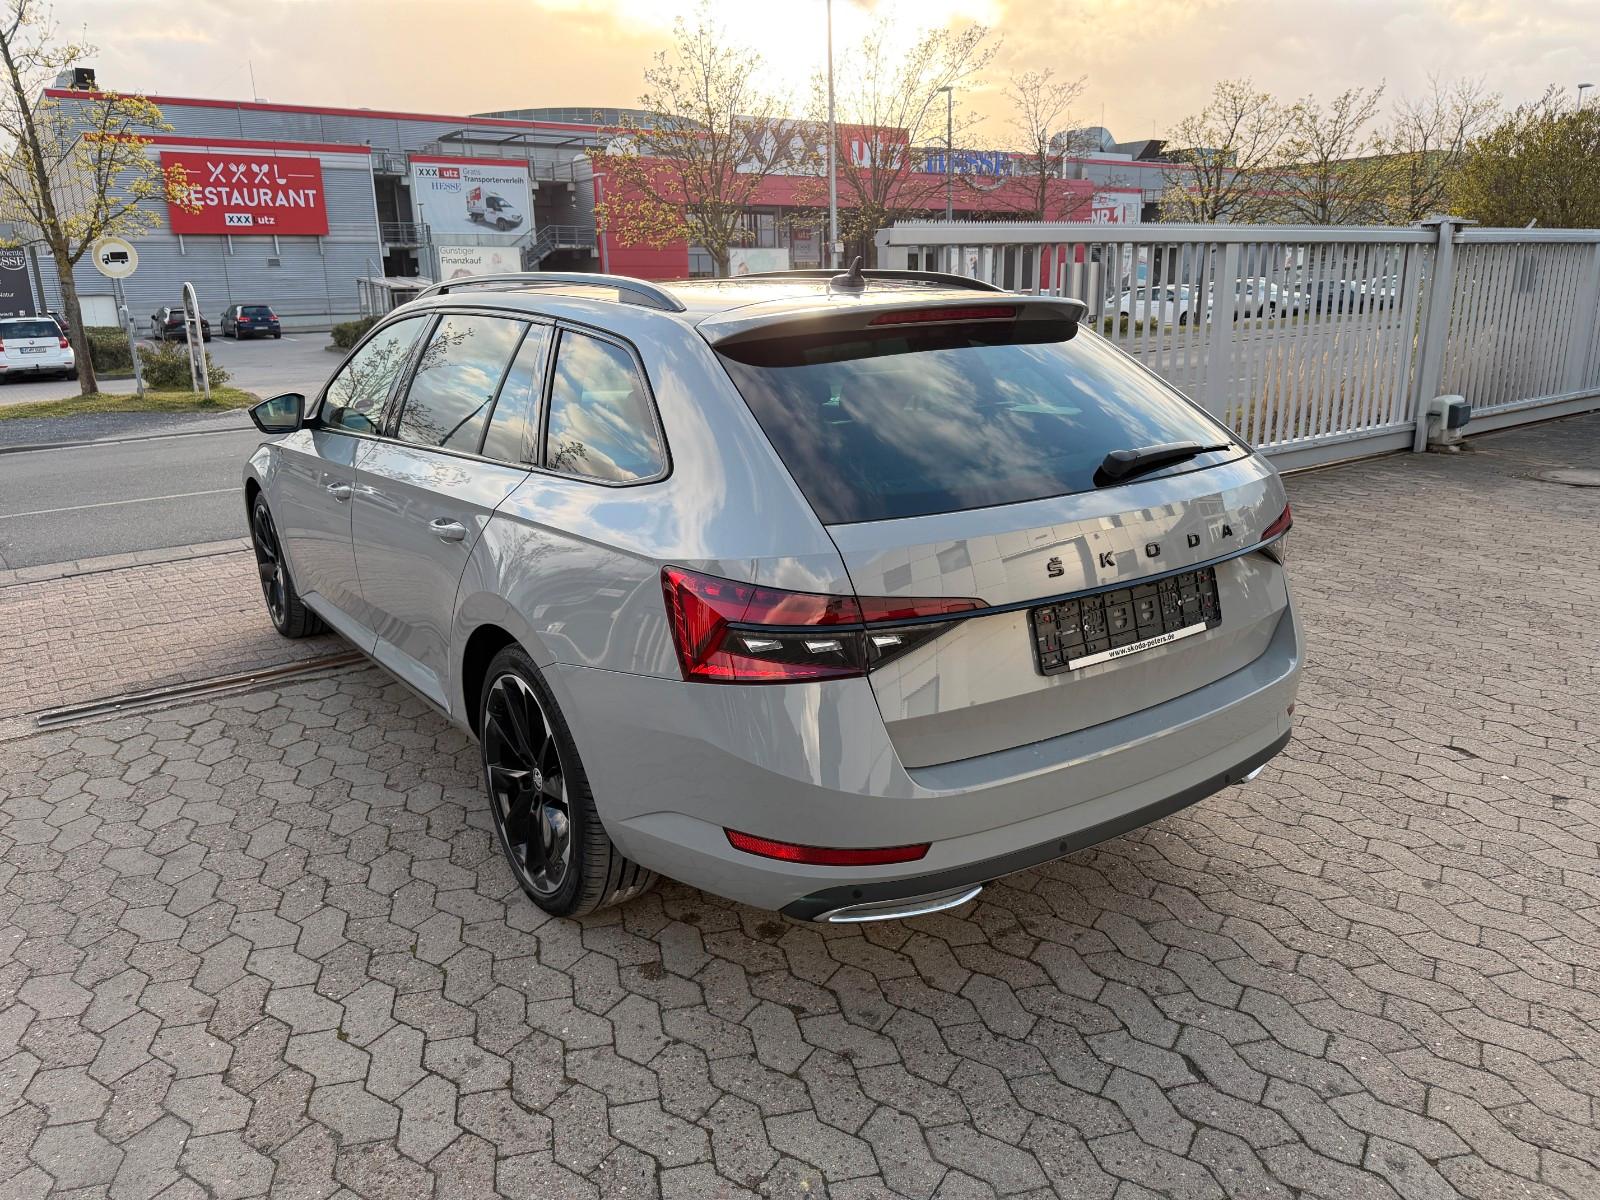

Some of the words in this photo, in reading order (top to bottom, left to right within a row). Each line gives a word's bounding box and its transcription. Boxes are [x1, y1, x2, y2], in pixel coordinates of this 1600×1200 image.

[206, 161, 287, 185] XXXL
[464, 175, 525, 185] Transporterverleih
[175, 185, 317, 208] RESTAURANT
[431, 181, 462, 191] HESSE
[441, 256, 482, 265] Finanzkauf
[1046, 523, 1234, 579] ŠKODA
[1108, 632, 1176, 658] www.skoda-peters.de
